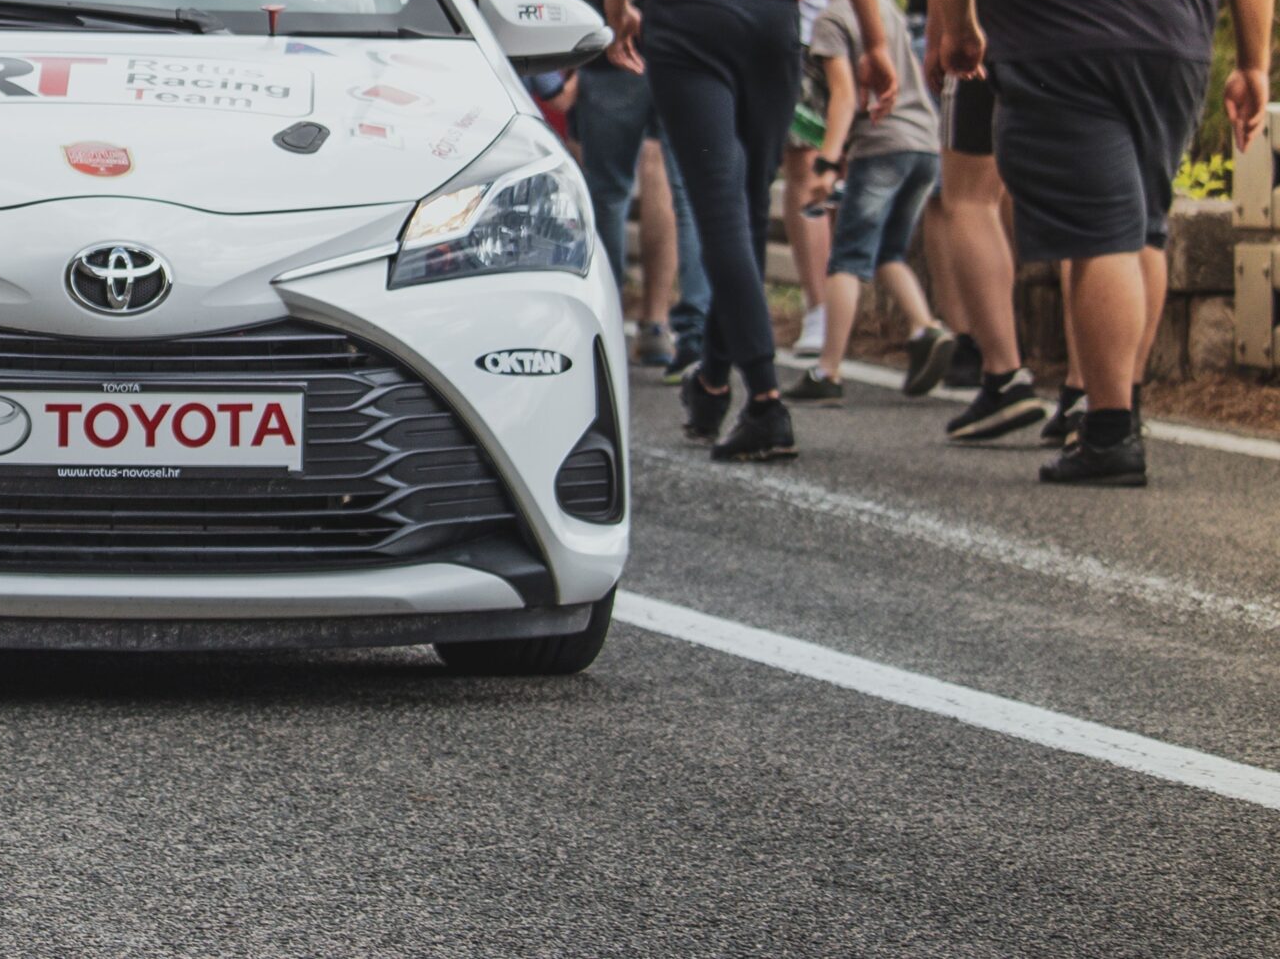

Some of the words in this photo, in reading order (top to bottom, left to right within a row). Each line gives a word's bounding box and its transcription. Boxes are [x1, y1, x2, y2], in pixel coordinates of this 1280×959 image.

[518, 3, 545, 20] RRT
[127, 58, 265, 78] Rotus
[126, 73, 291, 98] Racing
[125, 88, 253, 108] Team
[484, 351, 561, 374] OKTAN
[103, 383, 140, 393] TOYOTA
[44, 403, 296, 448] TOYOTA
[57, 467, 181, 479] www.rotus-novosel.hr
